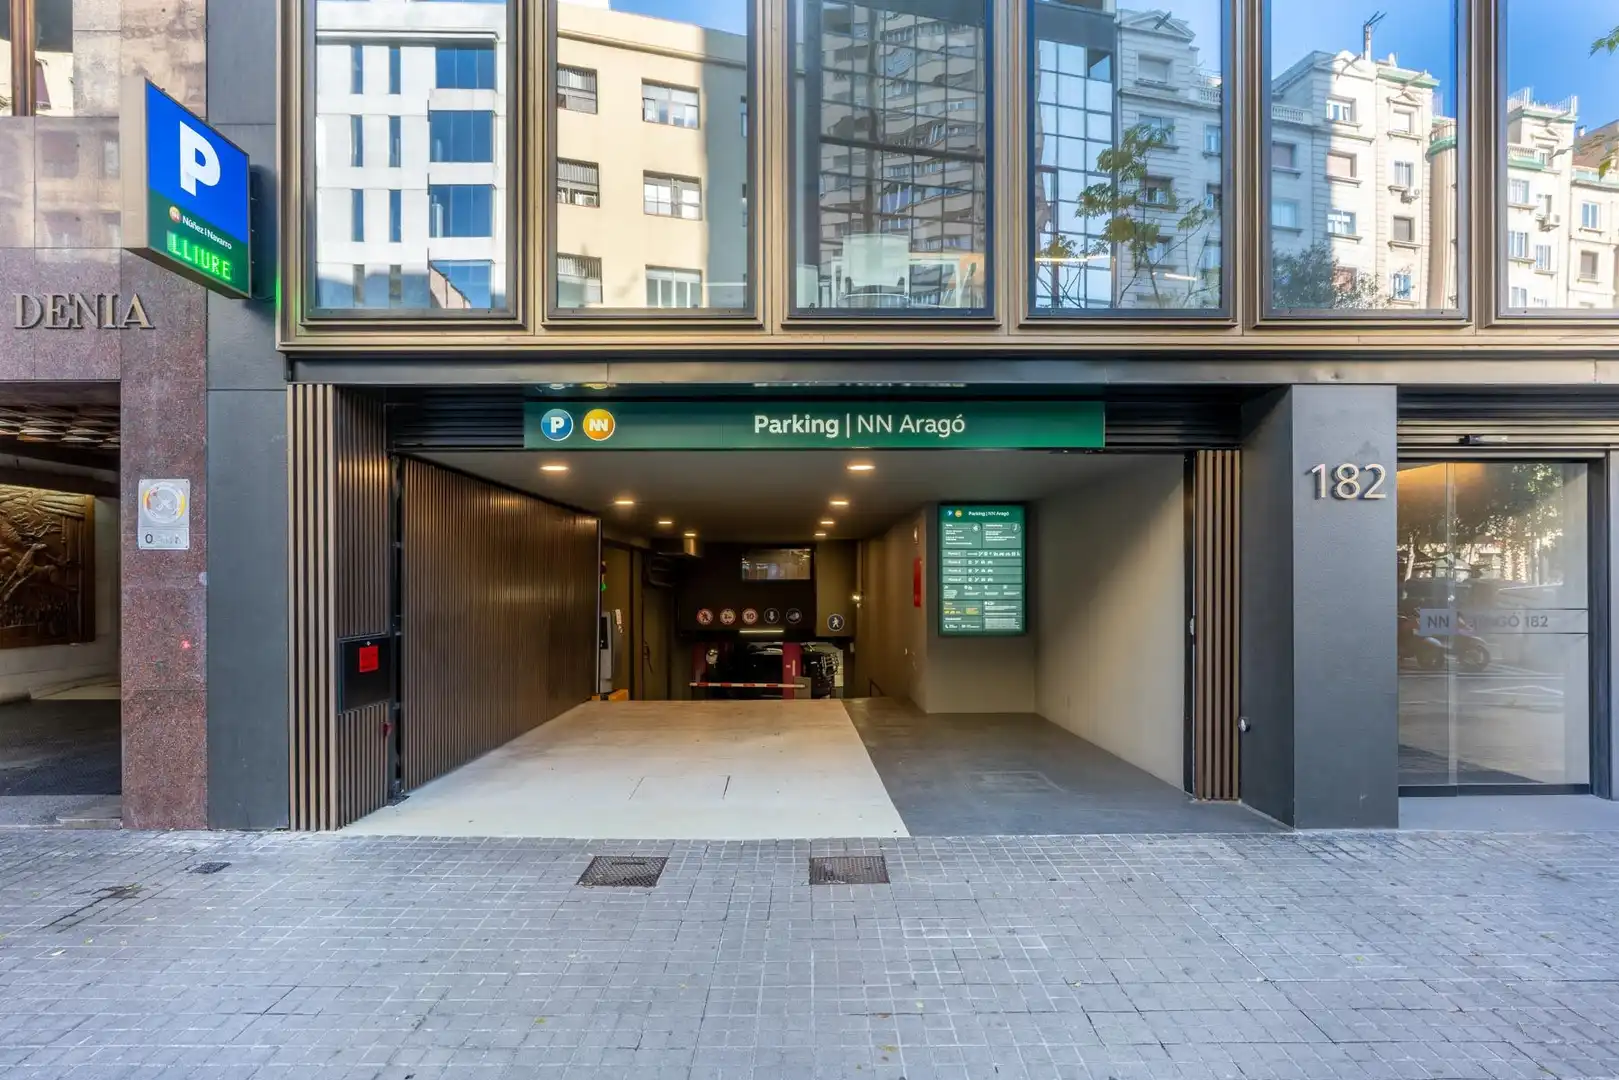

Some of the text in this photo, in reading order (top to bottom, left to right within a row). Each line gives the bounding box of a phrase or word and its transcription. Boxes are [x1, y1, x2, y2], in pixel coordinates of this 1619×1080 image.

[179, 120, 221, 197] P
[182, 215, 204, 234] Núñez
[207, 229, 232, 250] Navarro
[171, 233, 232, 281] LLIURE
[14, 291, 154, 331] DENIA
[753, 414, 840, 438] Parking
[857, 415, 893, 433] NN
[899, 413, 966, 439] Aragó
[1308, 463, 1387, 500] 182
[1427, 615, 1449, 629] NN
[1524, 616, 1548, 628] 182
